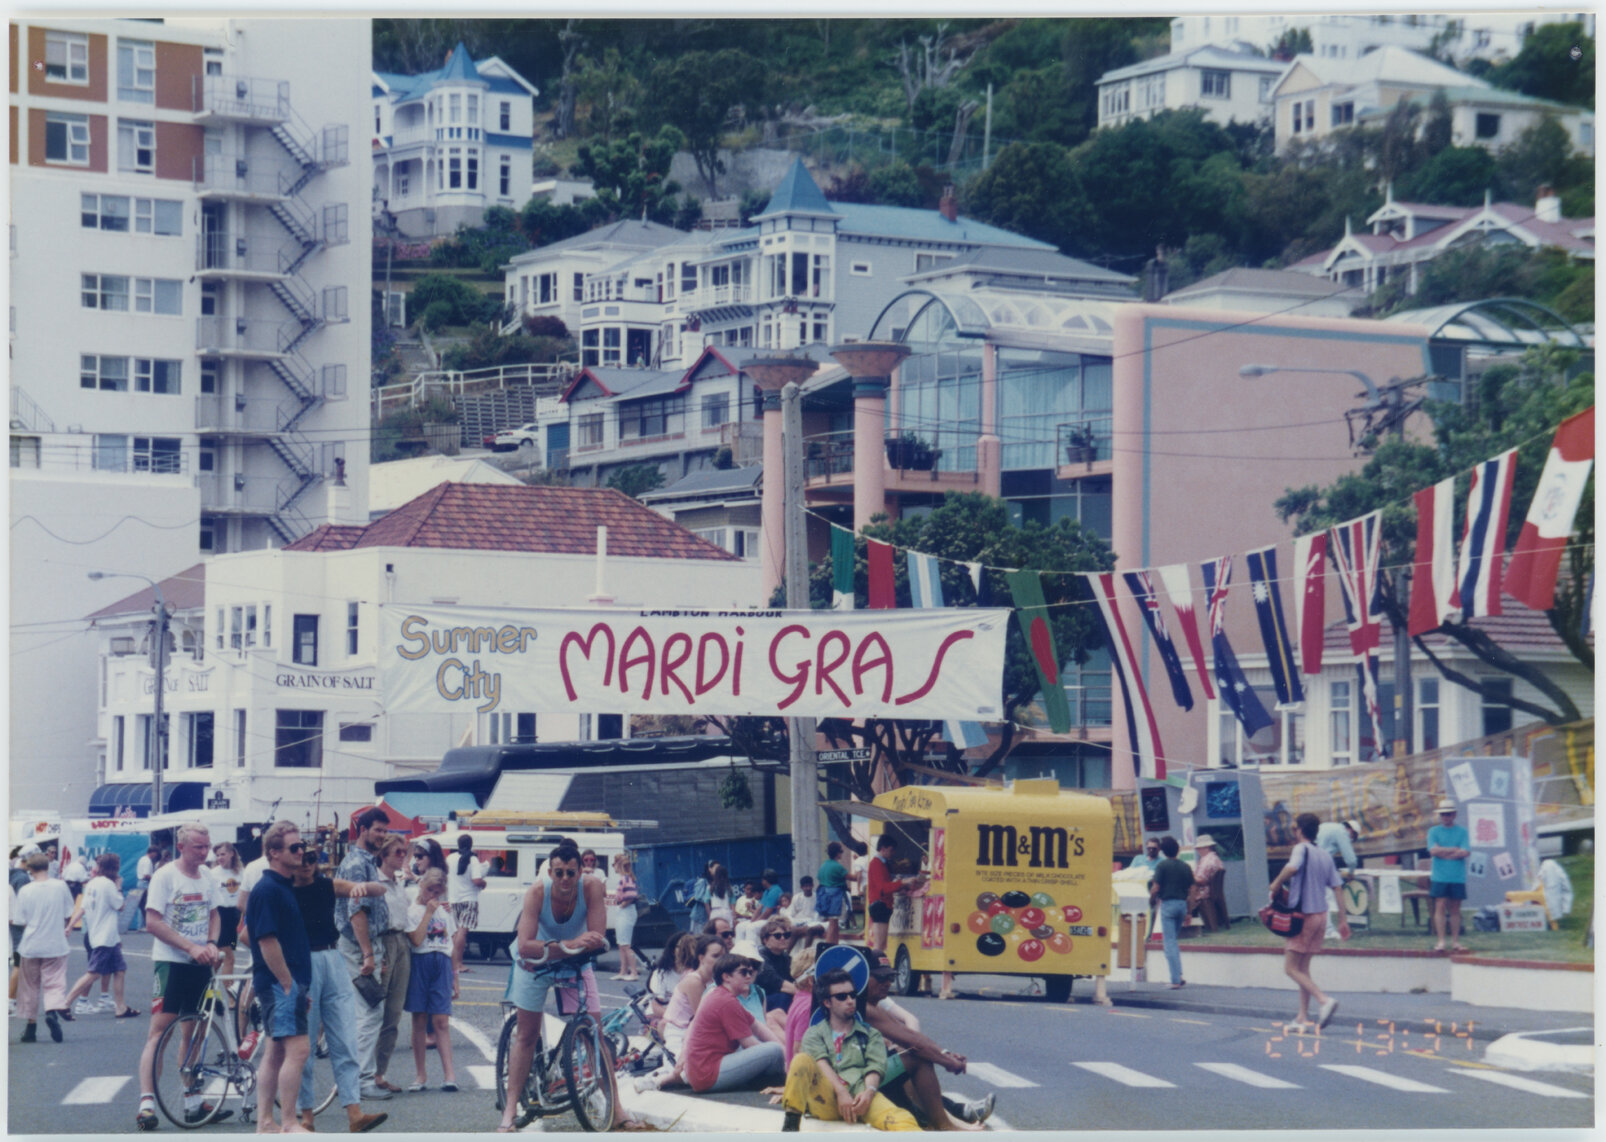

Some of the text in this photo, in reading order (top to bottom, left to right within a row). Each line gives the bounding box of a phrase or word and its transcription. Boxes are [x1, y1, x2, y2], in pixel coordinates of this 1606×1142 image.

[396, 615, 537, 660] Summer
[275, 673, 376, 690] GRAIN OF SALT
[768, 624, 975, 711] GRAS
[436, 657, 501, 713] City
[818, 750, 865, 761] ORIENTAL TCE
[91, 820, 120, 829] HOT
